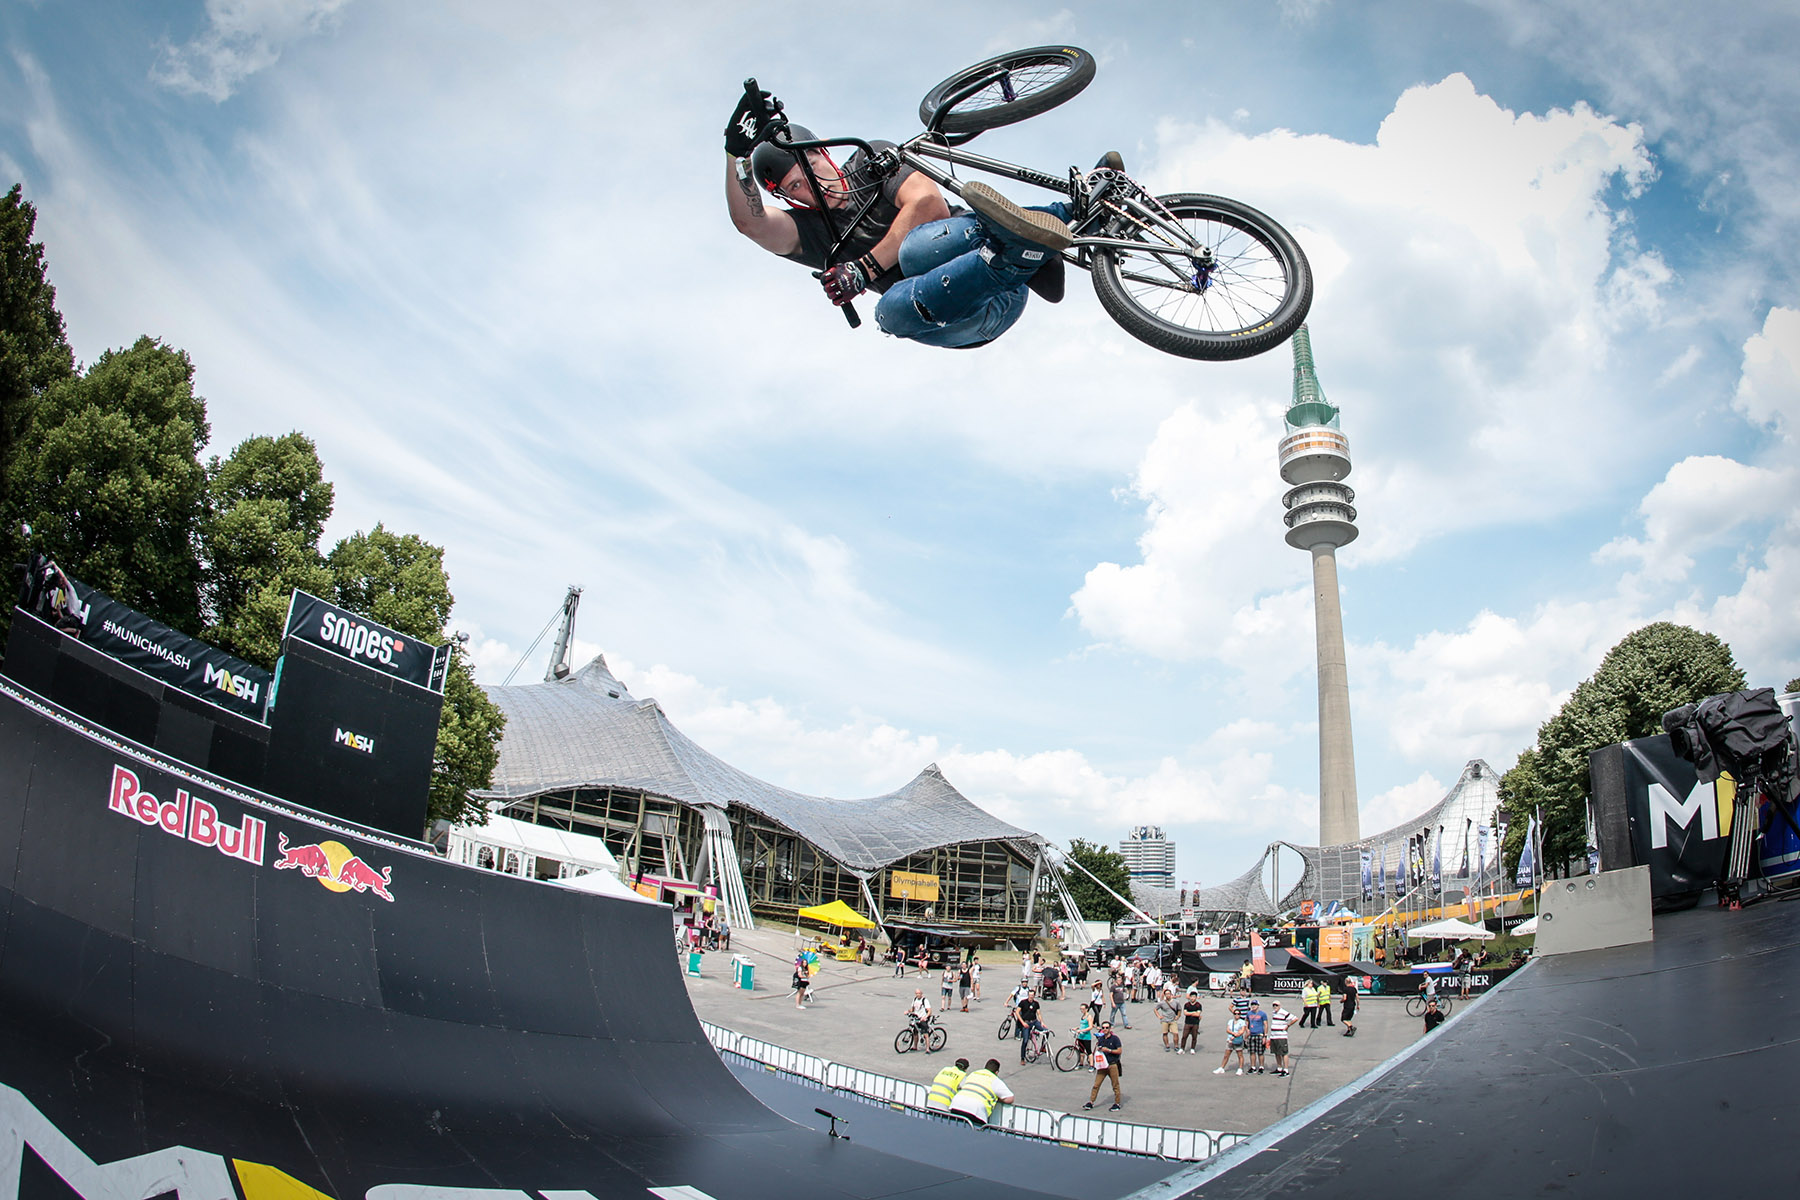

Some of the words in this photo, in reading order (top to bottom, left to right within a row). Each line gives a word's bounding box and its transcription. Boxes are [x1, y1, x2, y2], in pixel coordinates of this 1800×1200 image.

[102, 619, 191, 670] #MUNICHMASH
[203, 662, 260, 704] MASH
[335, 727, 375, 754] MASH
[893, 875, 938, 888] Olympiahalle
[1441, 974, 1490, 988] FURHER
